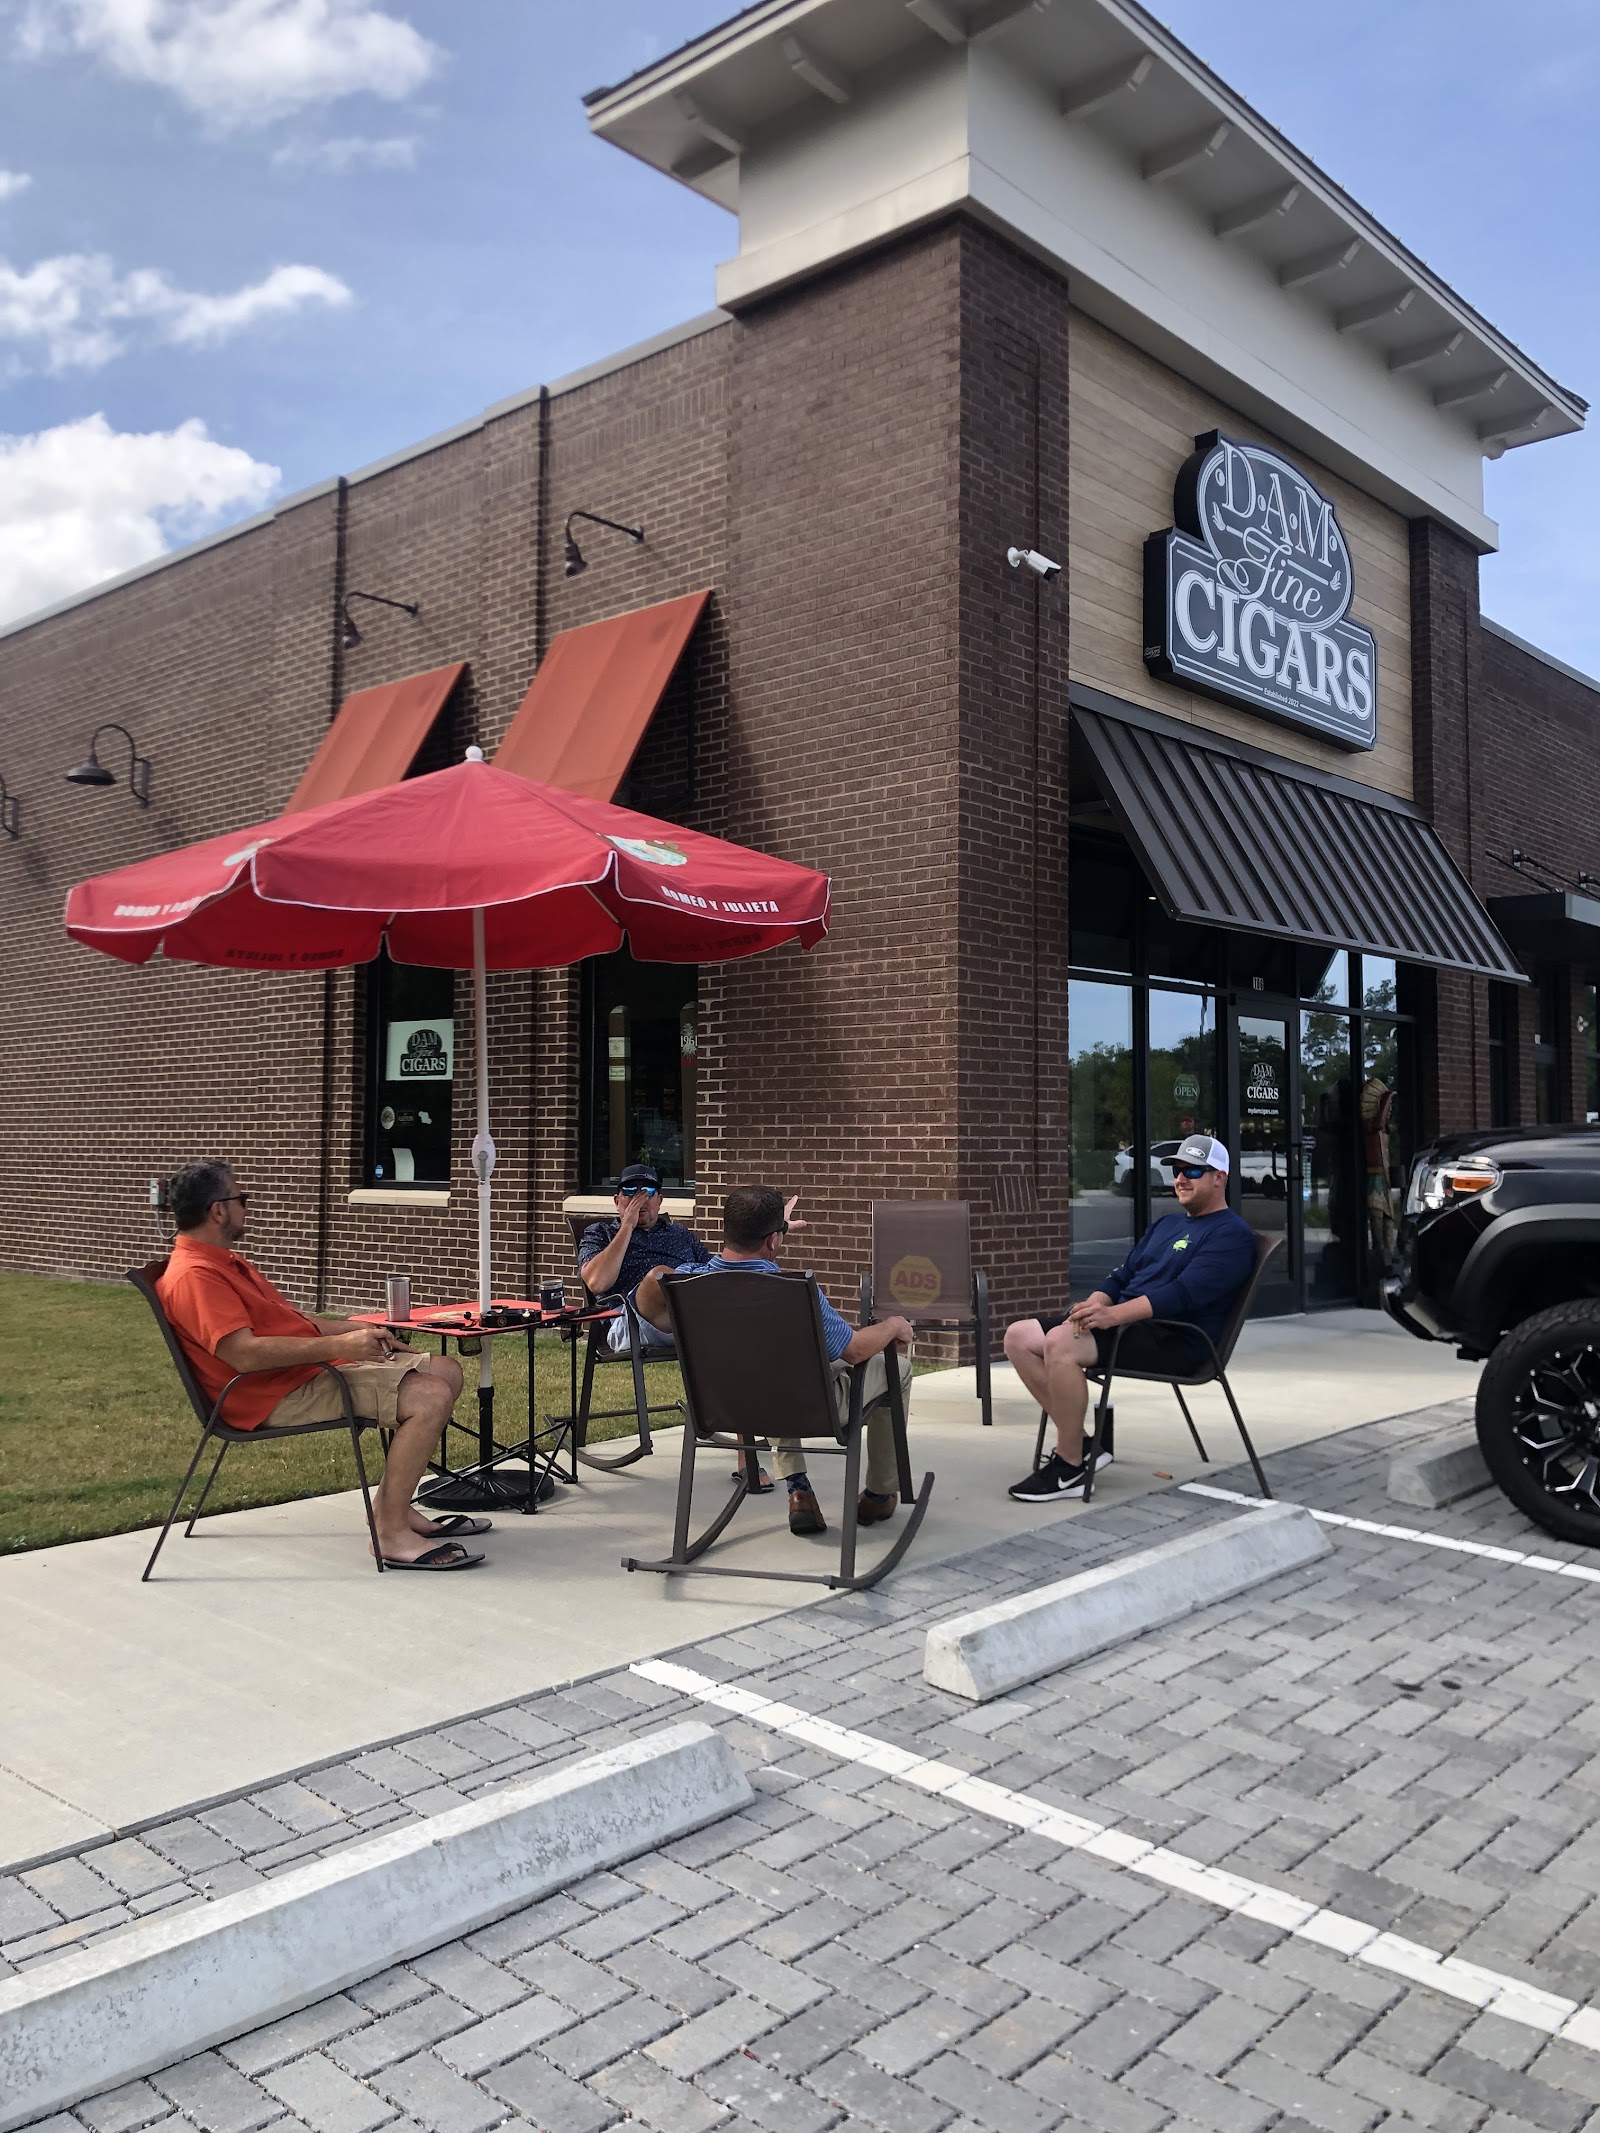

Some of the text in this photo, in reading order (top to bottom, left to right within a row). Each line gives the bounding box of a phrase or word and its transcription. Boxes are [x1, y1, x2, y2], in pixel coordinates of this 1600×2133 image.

[1175, 570, 1372, 721] CIGARS
[661, 885, 780, 912] ROMEO Y JULIETA
[411, 1032, 438, 1047] DAM
[680, 1035, 698, 1048] 1961
[401, 1057, 447, 1072] CIGARS
[1253, 1063, 1273, 1078] DAM
[1174, 1086, 1198, 1097] OPEN
[1246, 1085, 1279, 1100] CIGARS
[895, 1270, 938, 1291] ADS
